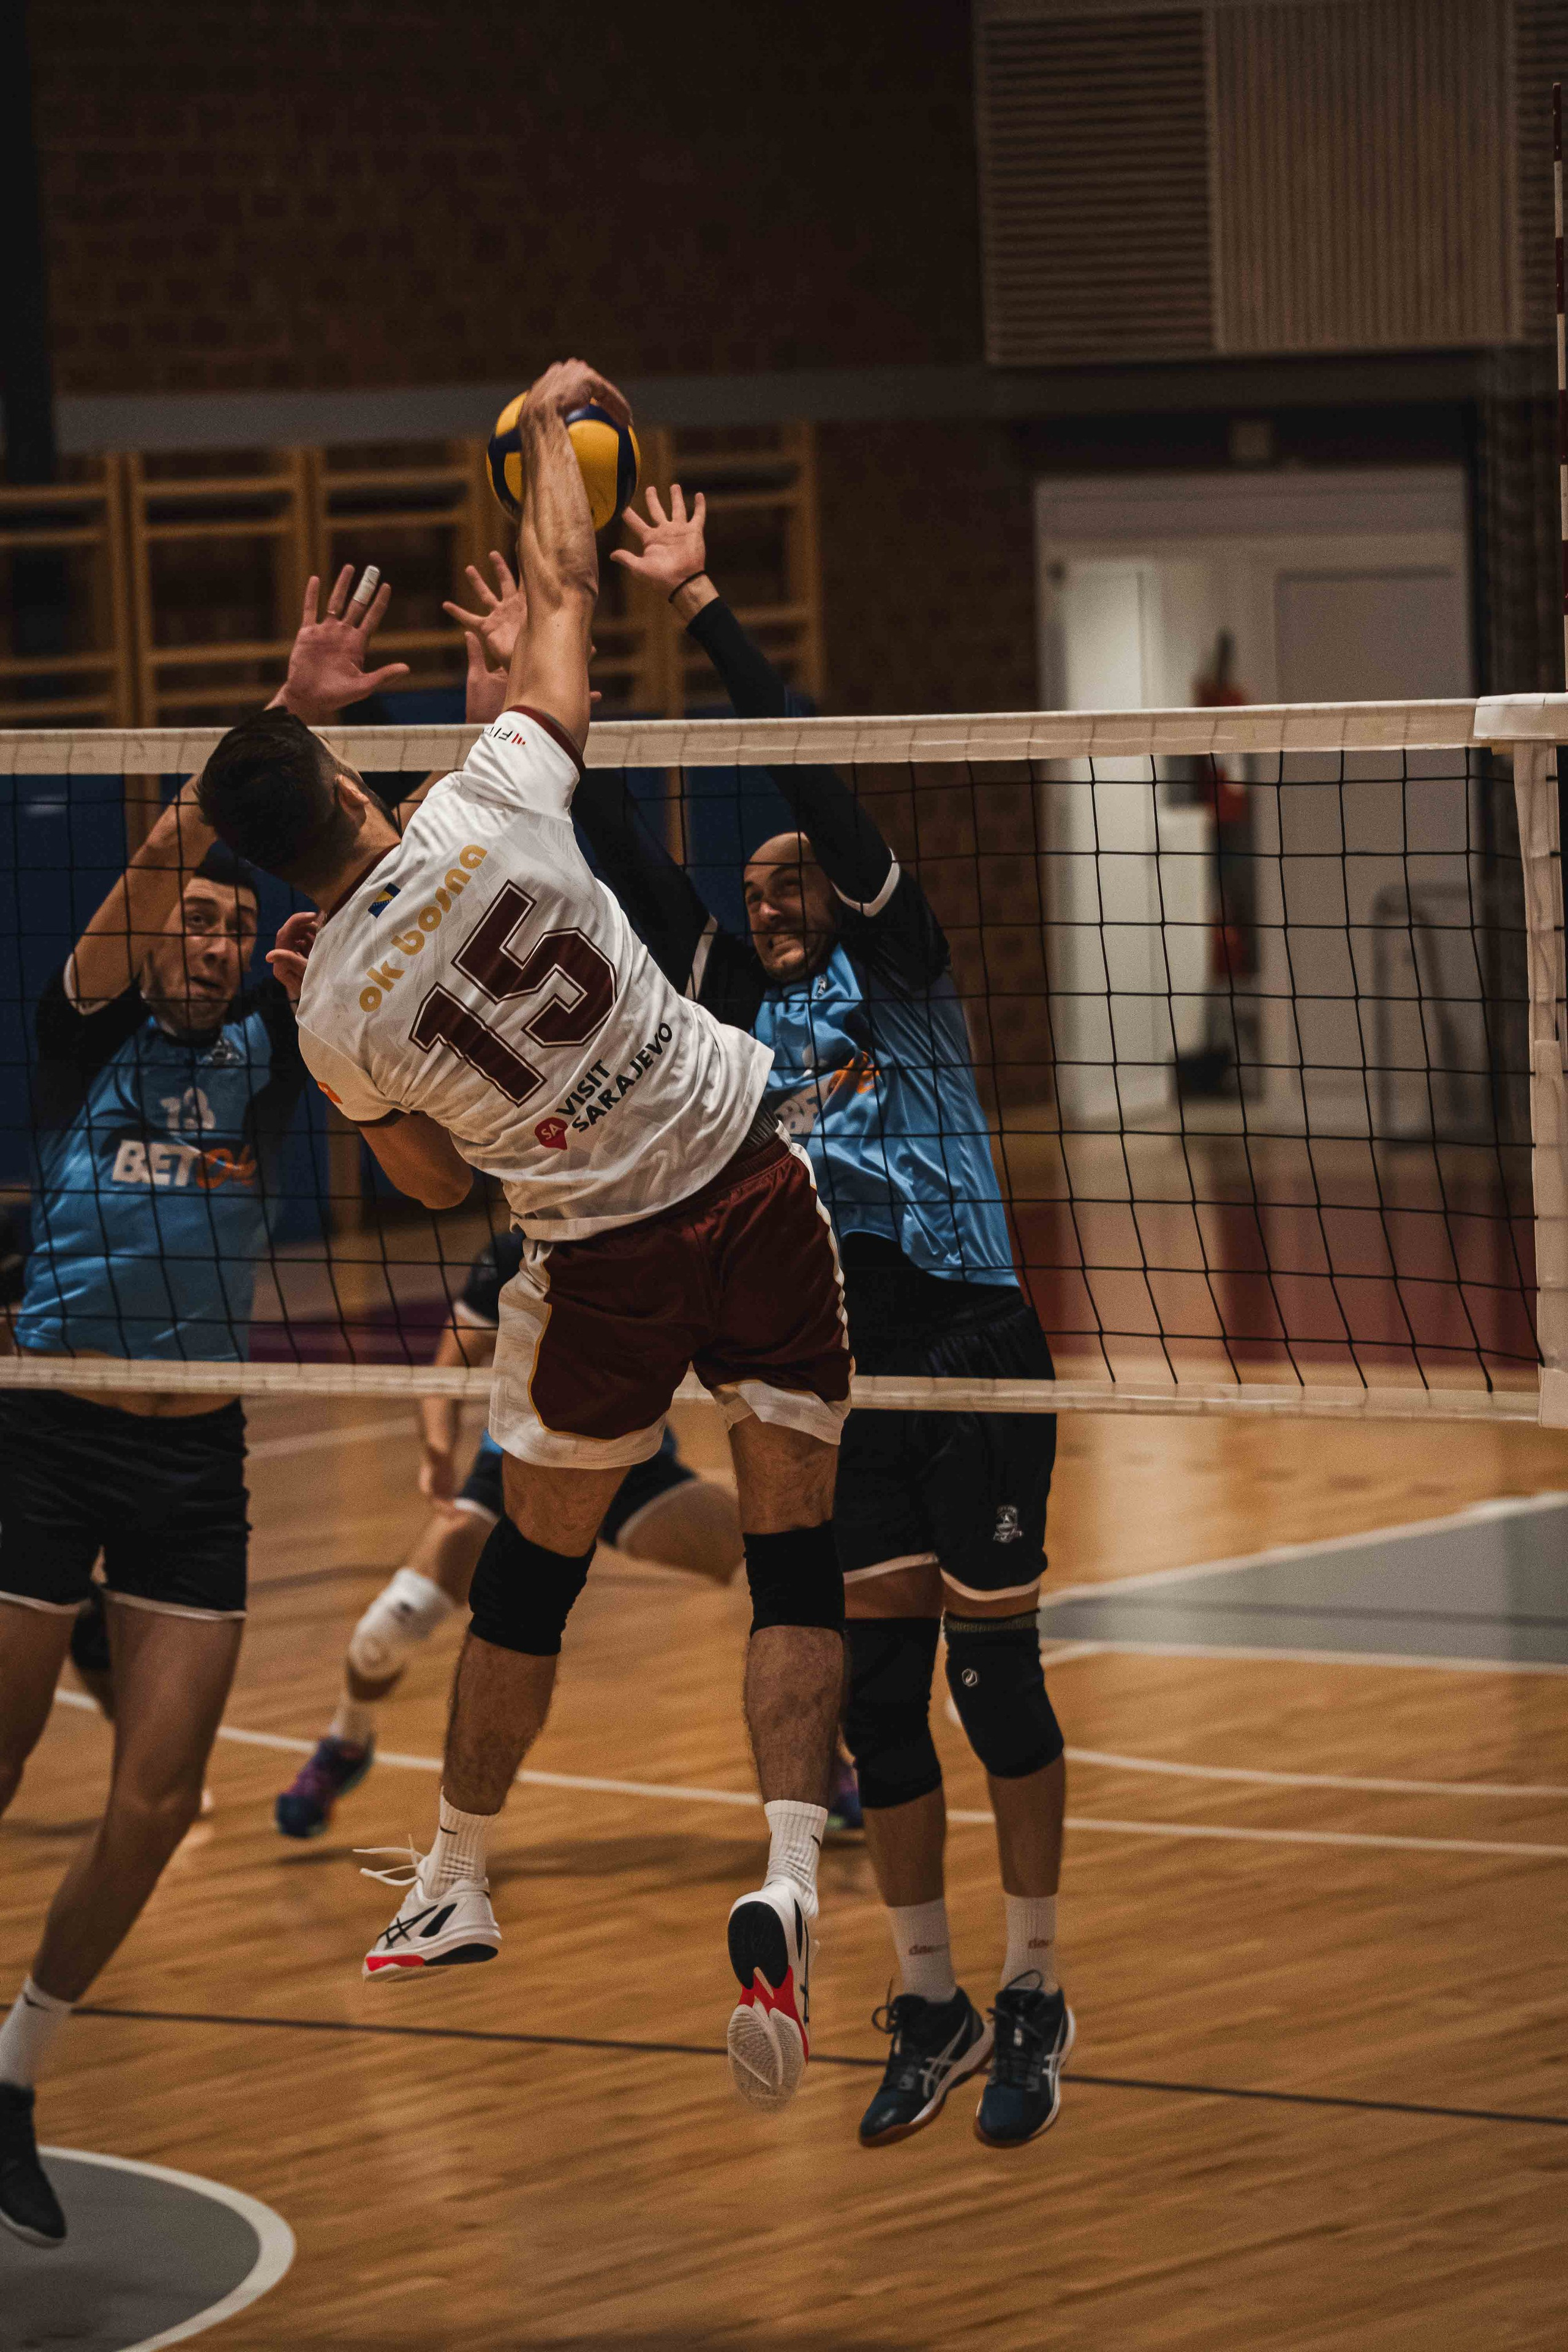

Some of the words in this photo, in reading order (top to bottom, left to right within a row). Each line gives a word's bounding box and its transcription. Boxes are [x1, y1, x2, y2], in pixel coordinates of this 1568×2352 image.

[359, 960, 405, 1012] ok
[391, 844, 488, 956] bosna
[408, 878, 617, 1108] 15
[540, 1123, 563, 1140] SA
[555, 1059, 611, 1116] VISIT
[571, 1022, 673, 1133] SARAJEVO
